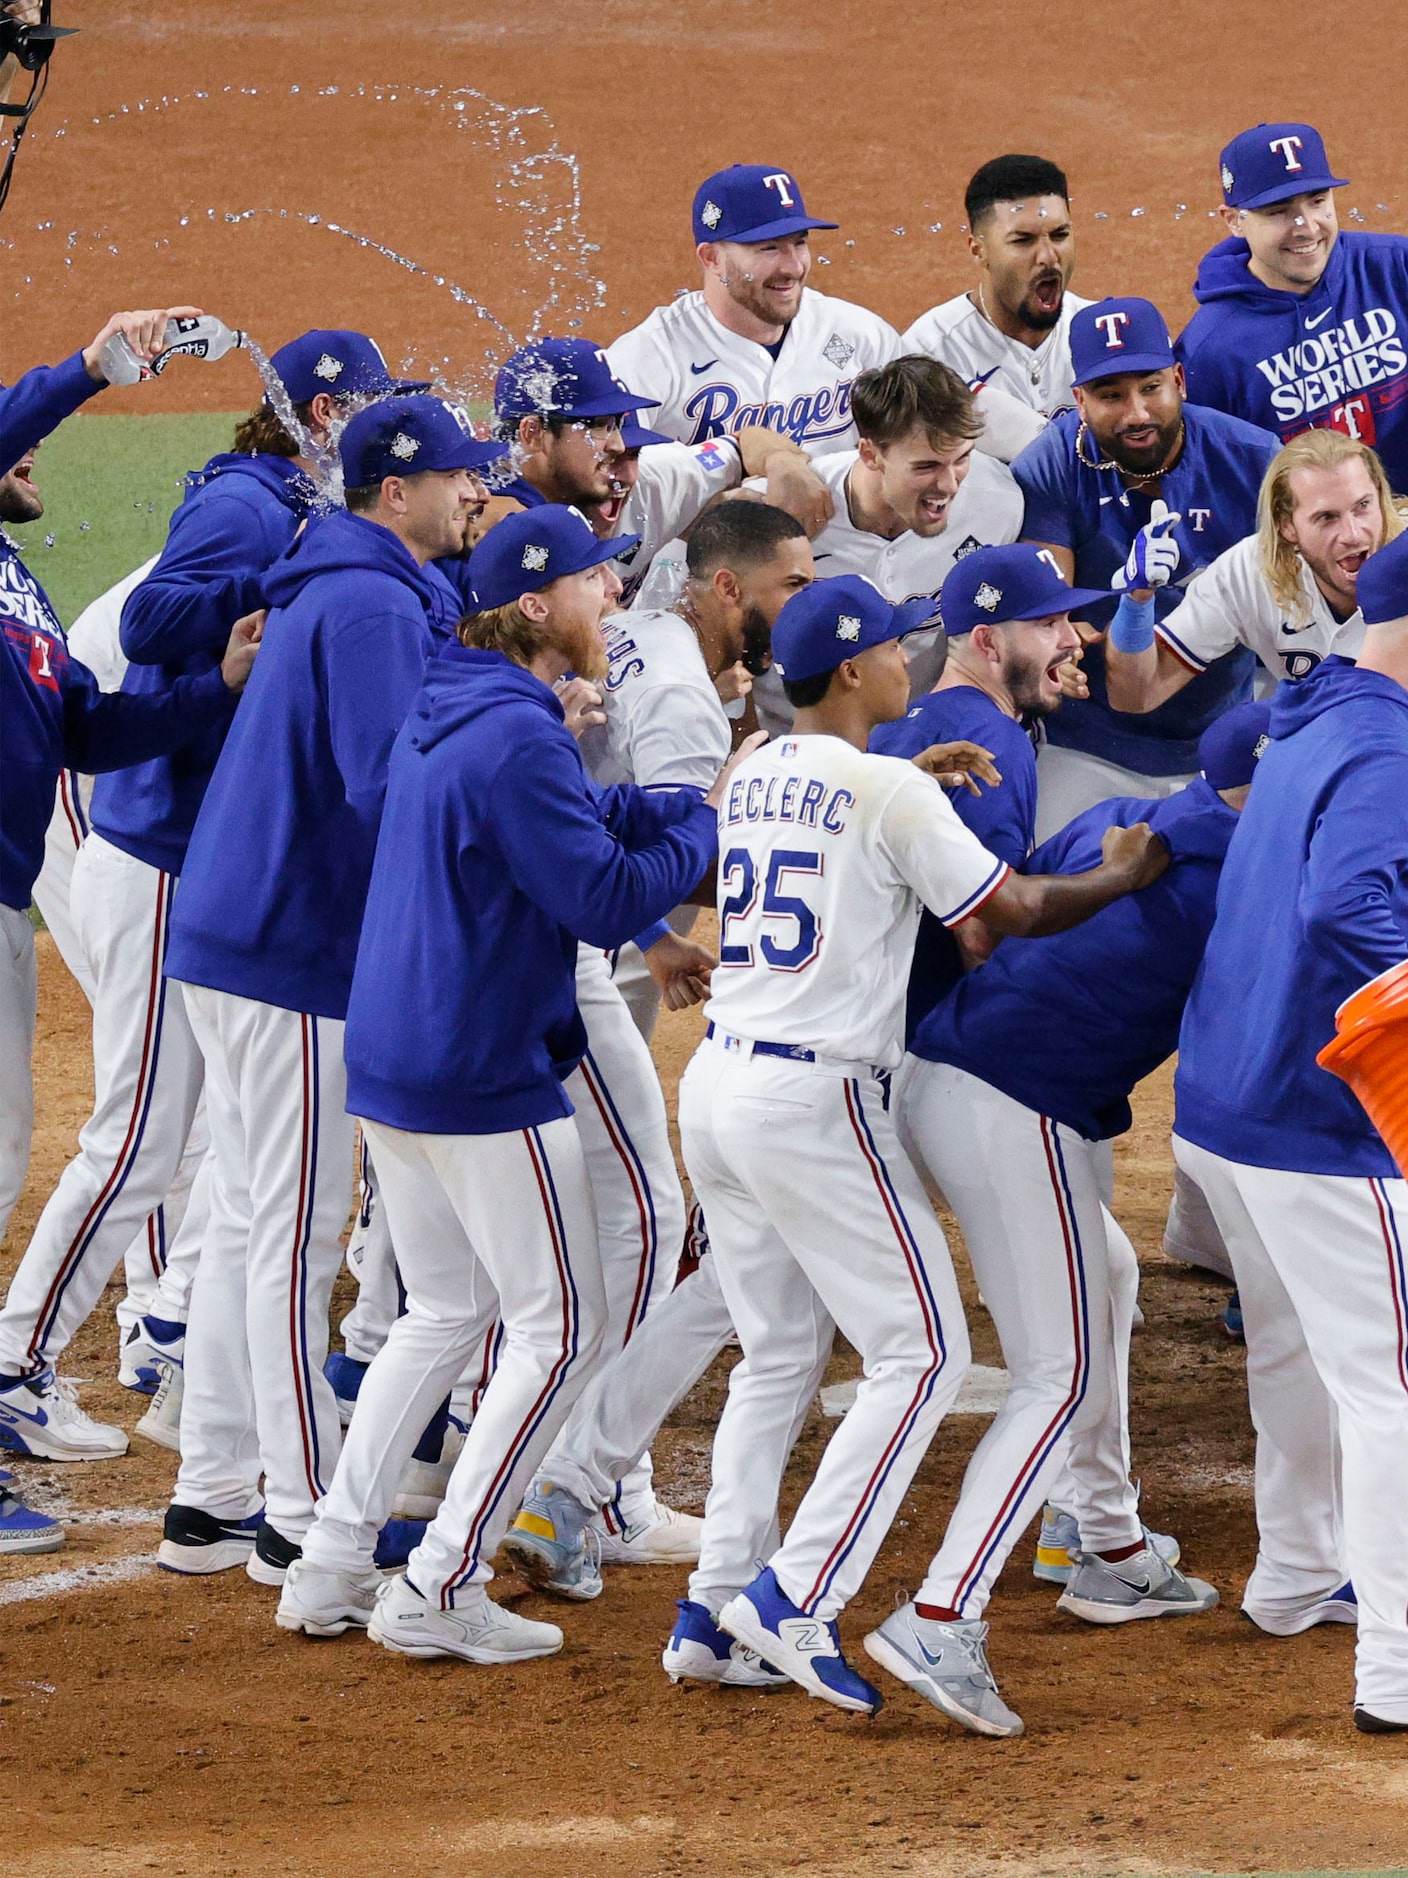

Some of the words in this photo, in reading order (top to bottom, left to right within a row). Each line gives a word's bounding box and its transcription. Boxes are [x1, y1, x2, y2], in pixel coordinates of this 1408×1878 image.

[1269, 136, 1304, 172] T
[763, 173, 795, 208] T
[1095, 312, 1130, 349] T
[1256, 308, 1397, 387] WORLD
[1271, 338, 1408, 422] SERIES
[683, 380, 856, 447] Ranger
[1334, 400, 1364, 440] T
[1188, 508, 1212, 531] T
[35, 635, 52, 677] T
[720, 848, 824, 973] 25
